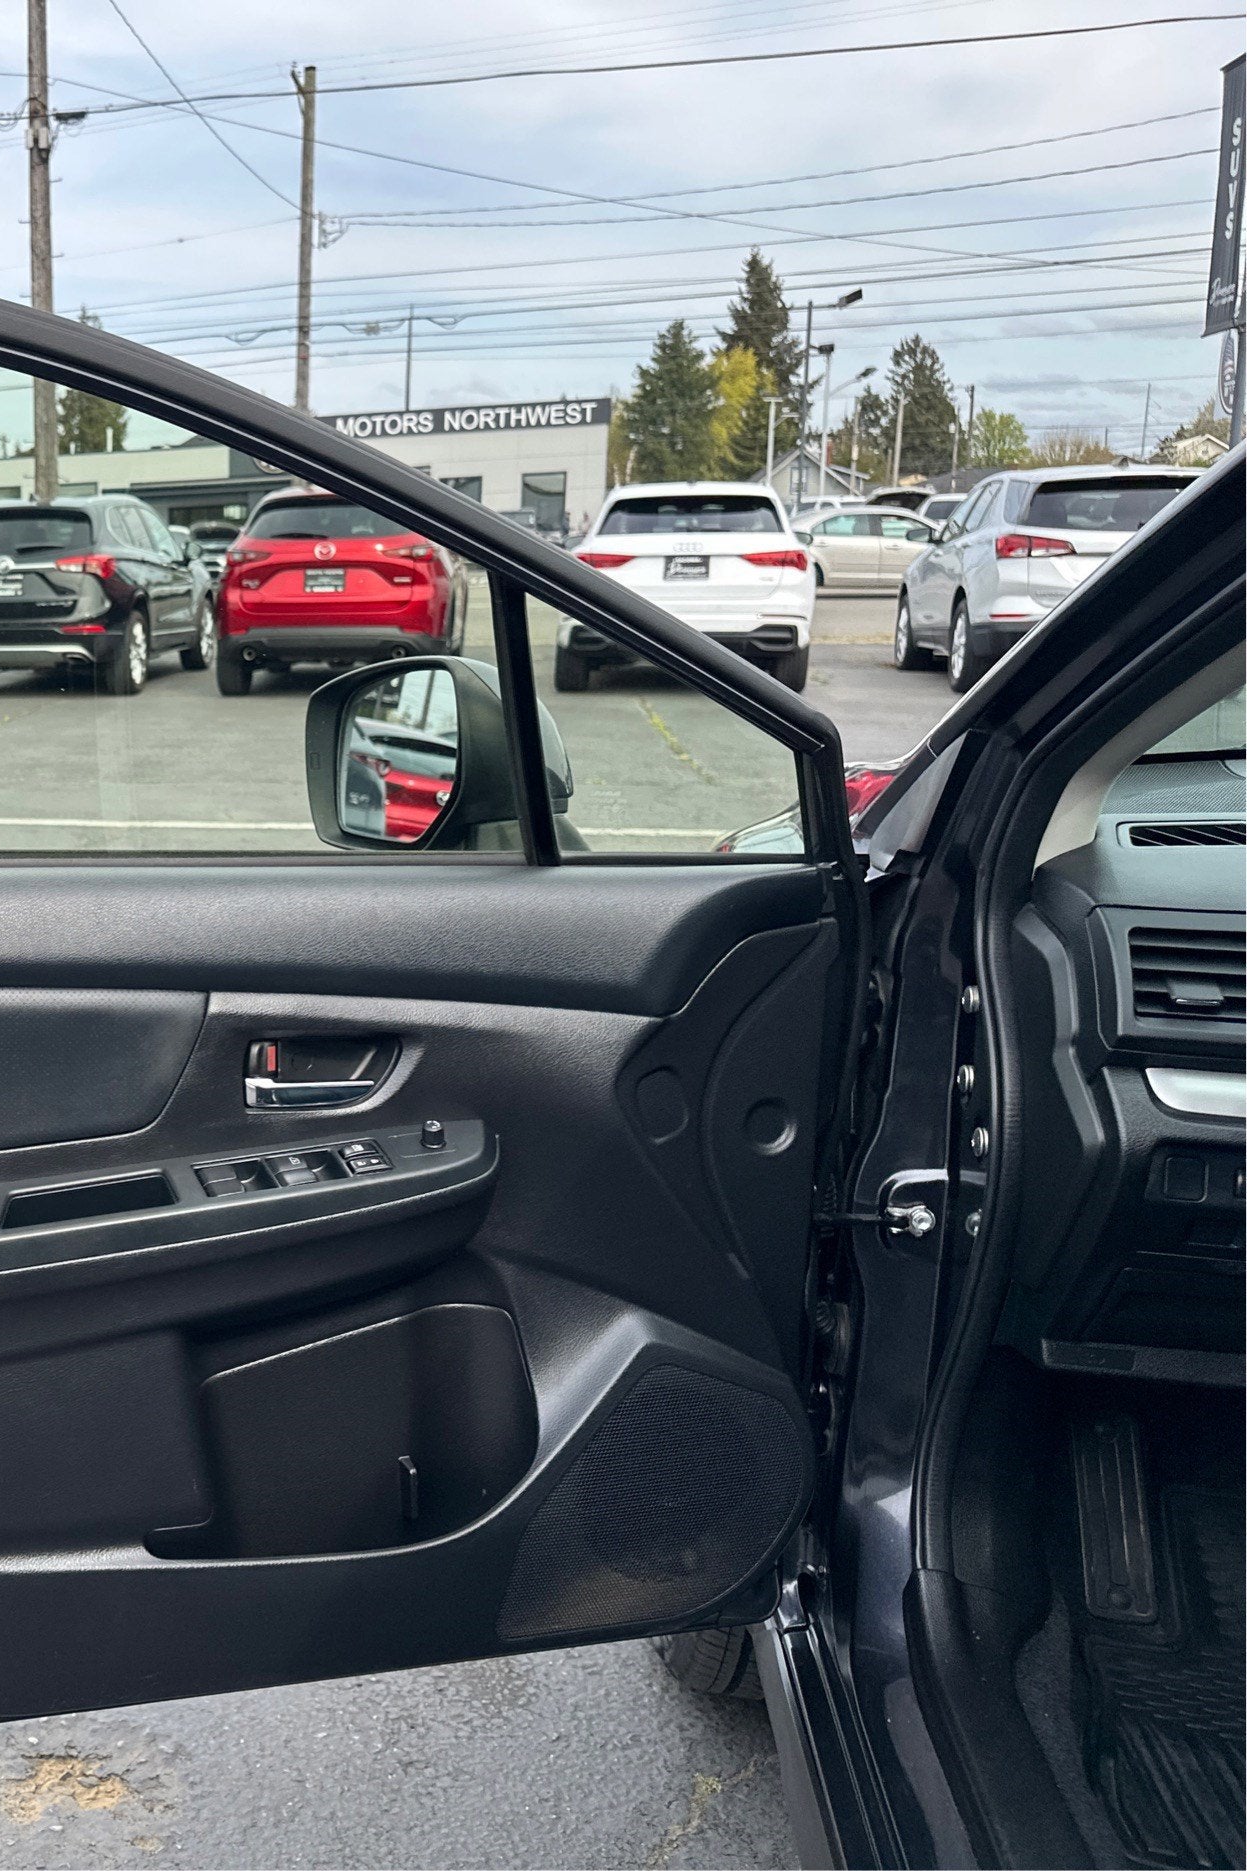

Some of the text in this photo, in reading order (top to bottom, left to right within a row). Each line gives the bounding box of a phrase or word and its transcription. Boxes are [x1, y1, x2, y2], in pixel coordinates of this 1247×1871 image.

[1224, 117, 1242, 240] SUVS
[335, 401, 598, 438] MOTORS NORTHWEST
